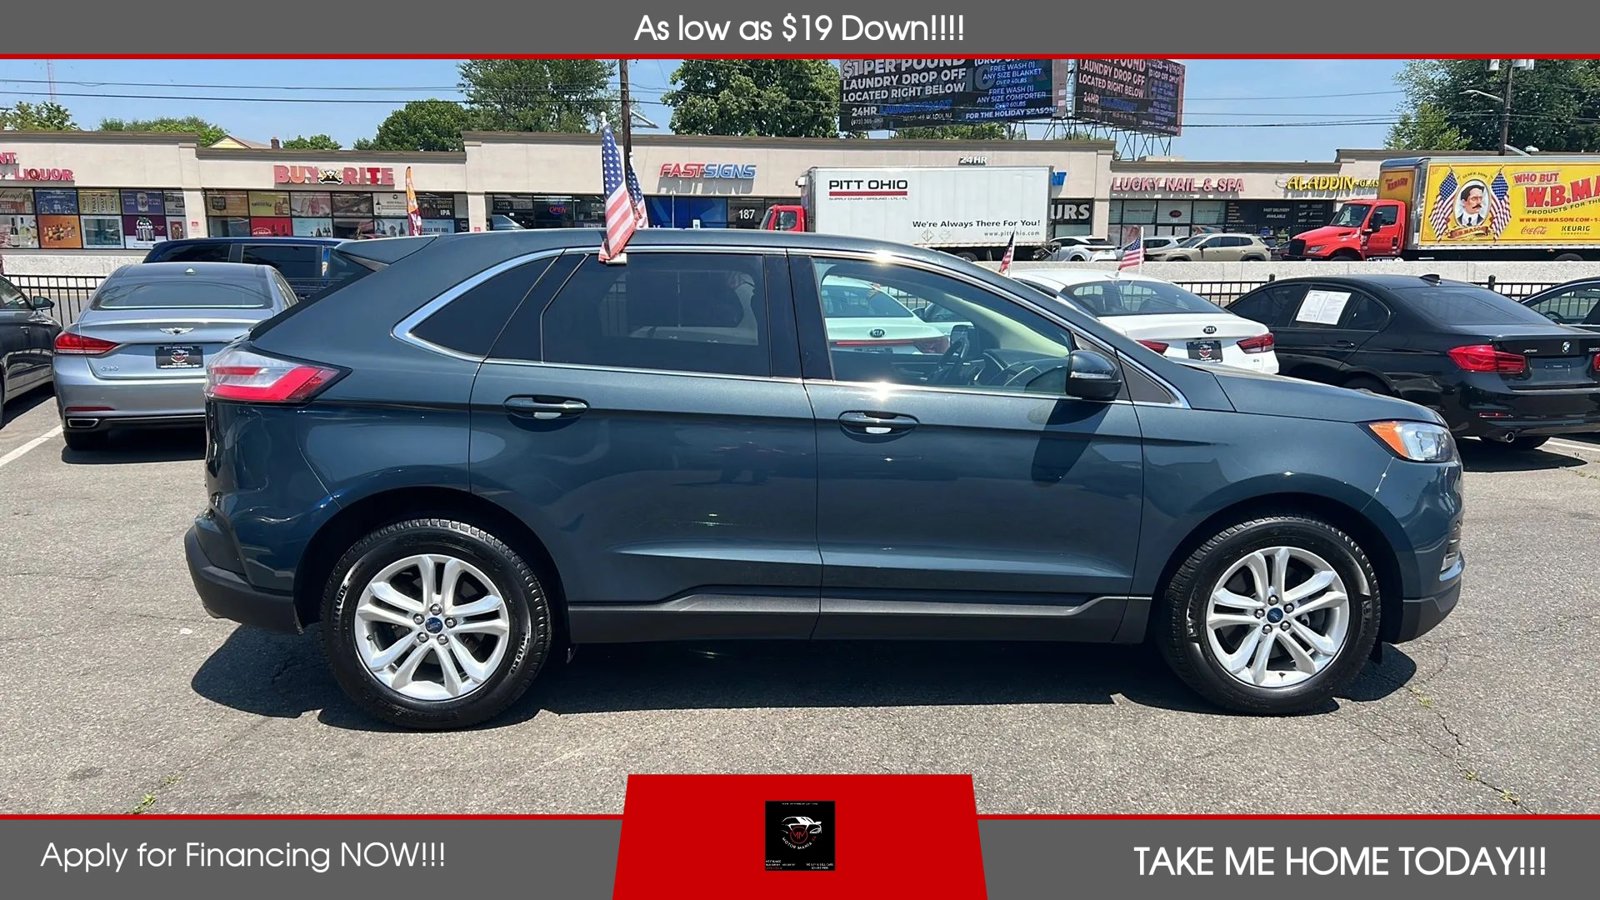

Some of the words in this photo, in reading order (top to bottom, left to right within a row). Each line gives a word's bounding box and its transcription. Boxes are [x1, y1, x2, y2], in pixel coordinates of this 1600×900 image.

[864, 59, 896, 75] PER
[1007, 62, 1026, 70] WASH
[1012, 68, 1042, 78] BLANKET
[1080, 59, 1113, 77] LAUNDRY
[1114, 68, 1132, 82] DROP
[1133, 73, 1146, 86] OFF
[843, 75, 899, 90] LAUNDRY
[902, 71, 938, 84] DROP
[941, 68, 966, 81] OFF
[1078, 72, 1106, 89] LOCATED
[1107, 80, 1124, 94] RIGHT
[1124, 86, 1144, 98] BELOW
[843, 90, 888, 102] LOCATED
[891, 86, 922, 98] RIGHT
[925, 82, 966, 95] BELOW
[1006, 91, 1046, 101] COMFORTER
[1084, 92, 1100, 104] 24HR
[851, 106, 878, 117] 24HR
[994, 109, 1024, 118] HOLIDAY
[959, 156, 988, 164] 24HR
[14, 168, 74, 181] LIQUOR
[274, 165, 320, 185] BUY
[342, 167, 395, 186] RITE
[660, 163, 756, 178] FASTSIGNS
[1286, 176, 1354, 191] ALADDIN
[1514, 173, 1536, 184] WHO
[1540, 172, 1559, 182] BUT
[829, 180, 864, 190] PITT
[868, 180, 908, 190] OHIO
[1112, 177, 1162, 192] LUCKY
[1165, 177, 1198, 192] NAIL
[1203, 178, 1214, 192] &
[1218, 178, 1246, 192] SPA
[739, 209, 755, 220] 187
[1527, 206, 1568, 214] PRODUCTS
[940, 220, 973, 228] Always
